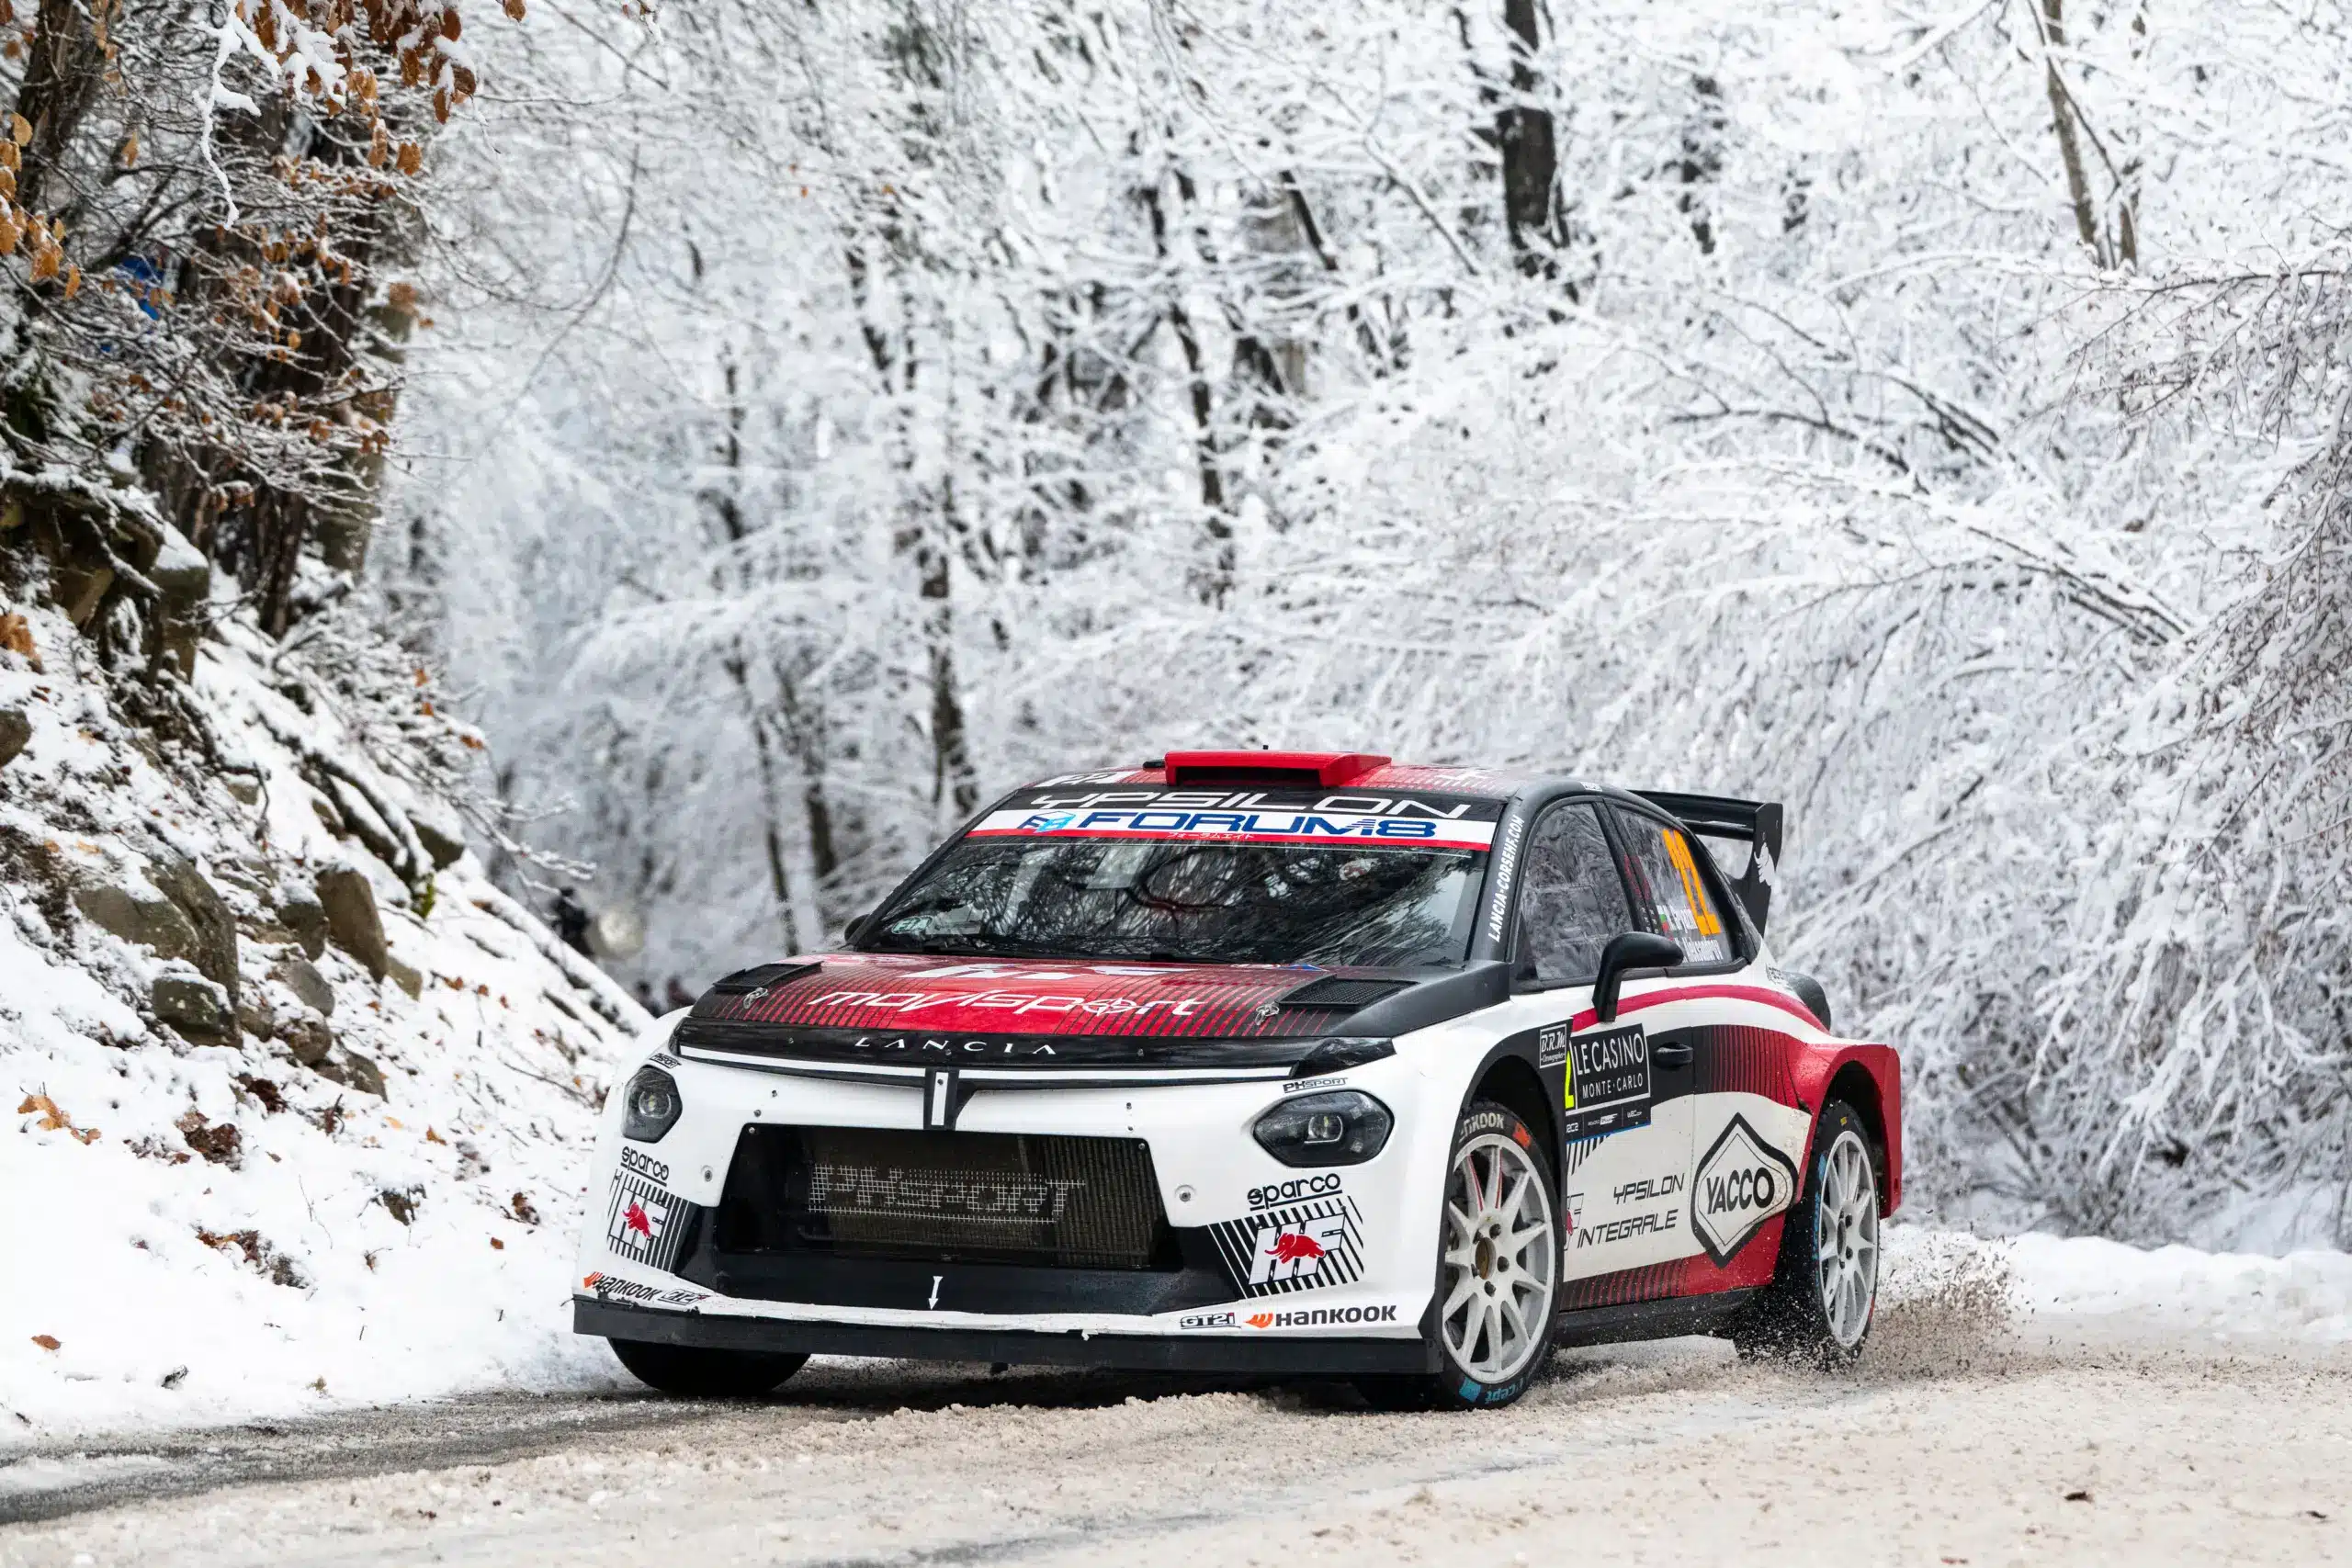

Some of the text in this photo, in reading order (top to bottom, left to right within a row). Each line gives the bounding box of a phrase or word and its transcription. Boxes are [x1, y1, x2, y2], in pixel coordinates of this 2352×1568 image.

[1031, 791, 1472, 819] YPSILON
[1077, 811, 1436, 838] FORUM8
[854, 1037, 1057, 1055] LANCIA
[1574, 1032, 1645, 1076] LE CASINO
[1283, 1077, 1349, 1093] PHSPORT
[622, 1146, 670, 1181] sparco
[1247, 1173, 1341, 1210] sparco
[1613, 1173, 1685, 1204] YPSILON
[1706, 1167, 1775, 1215] YACCO
[1577, 1209, 1679, 1249] INTEGRALE
